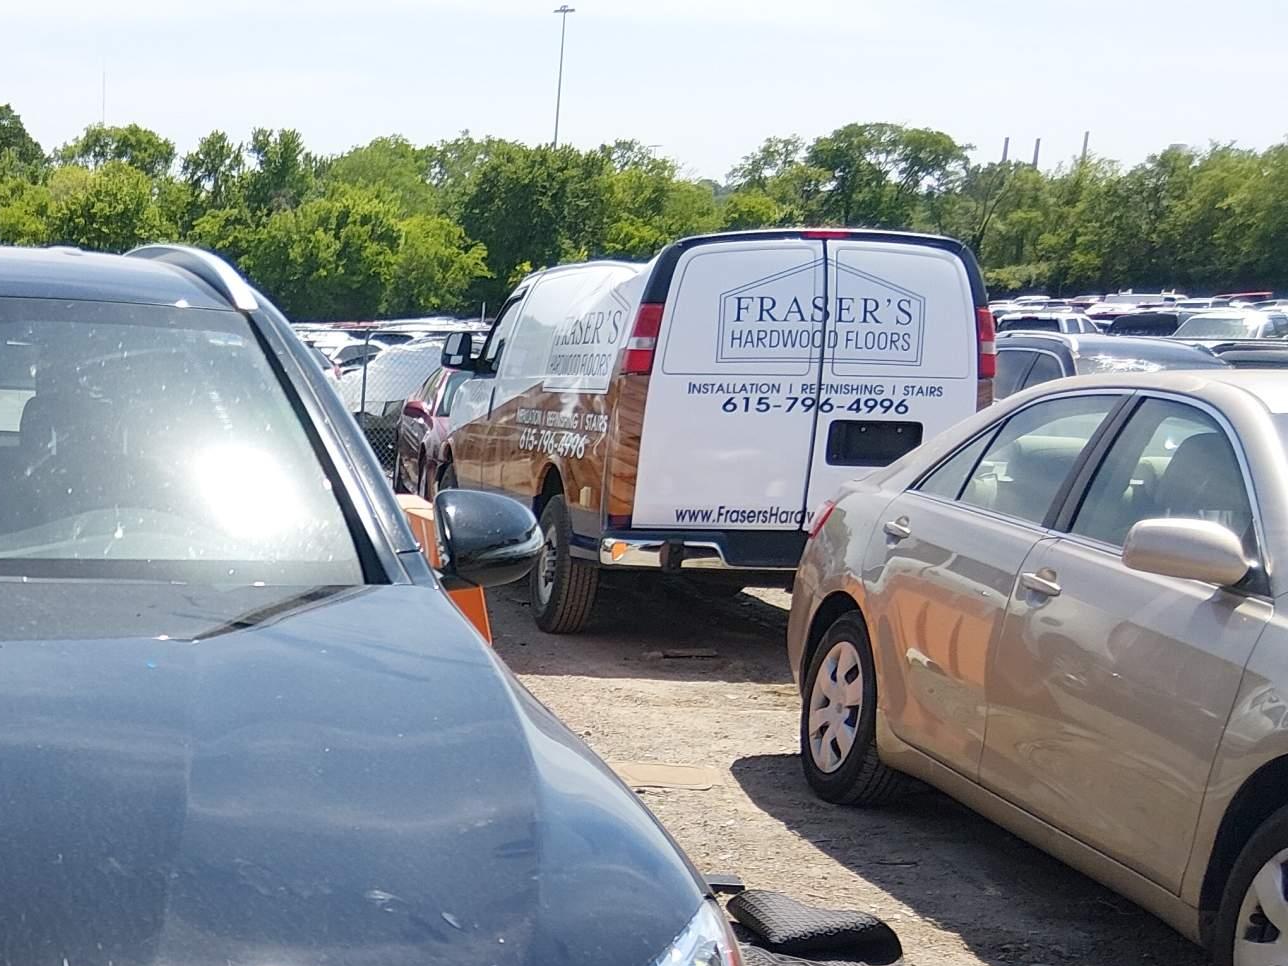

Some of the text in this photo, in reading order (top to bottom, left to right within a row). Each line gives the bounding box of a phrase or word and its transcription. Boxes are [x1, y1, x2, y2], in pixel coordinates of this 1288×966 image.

[733, 295, 913, 326] FRASER'S
[730, 329, 912, 352] HARDWOOD FLOORS
[687, 381, 781, 395] INSTALLATION
[800, 383, 885, 397] REFINISHING
[902, 385, 944, 398] STAIRS
[721, 396, 910, 415] 615-796-4996
